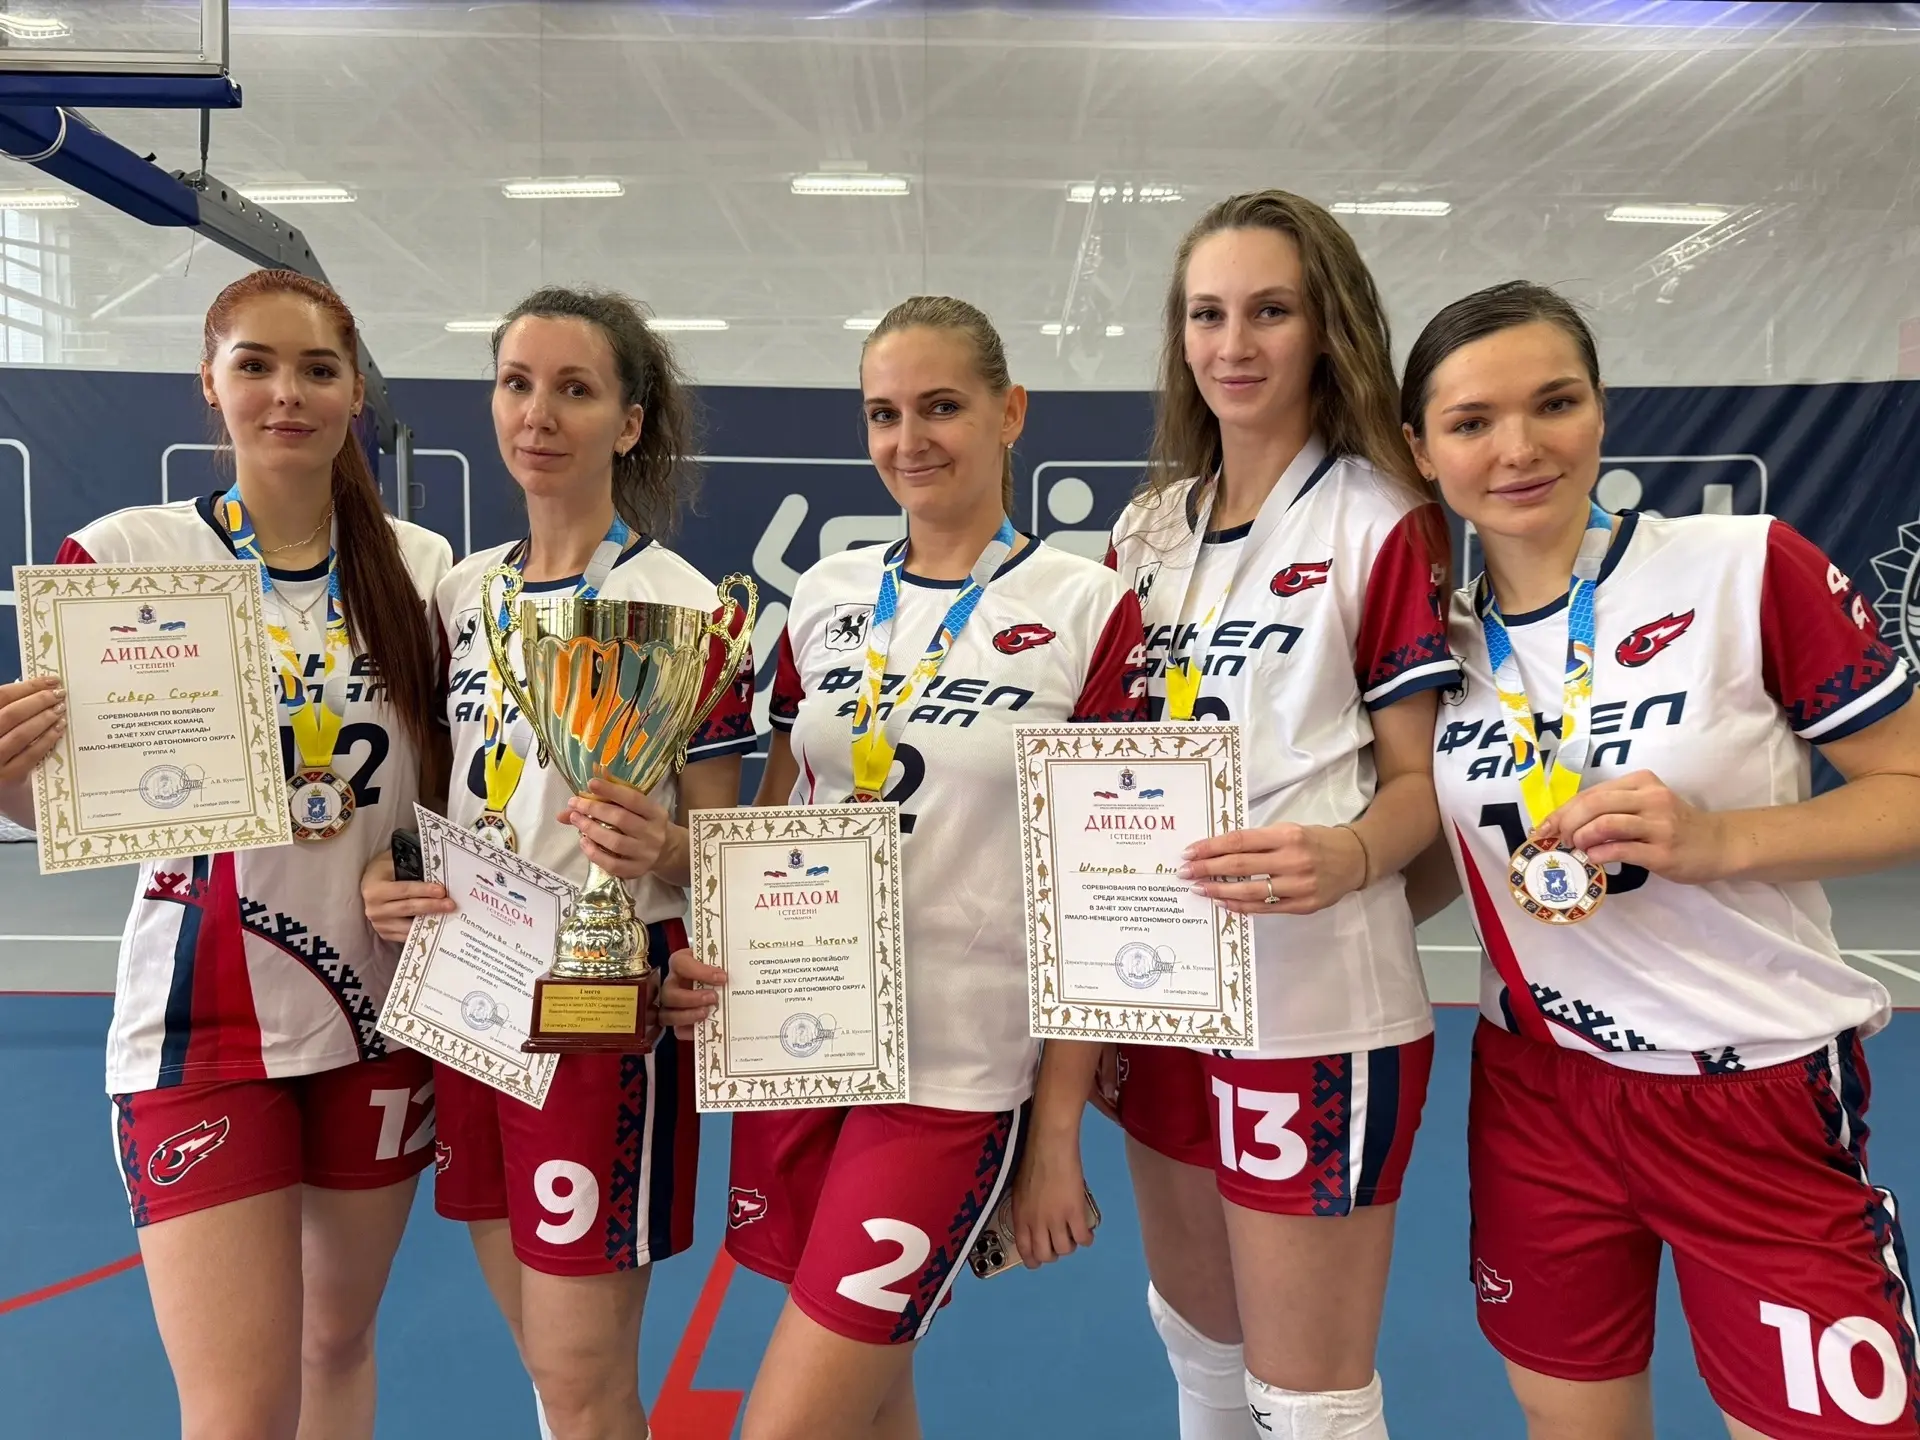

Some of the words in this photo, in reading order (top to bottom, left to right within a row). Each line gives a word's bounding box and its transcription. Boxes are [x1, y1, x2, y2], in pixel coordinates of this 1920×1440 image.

[100, 644, 199, 664] ДИПЛОМ
[134, 662, 175, 670] СТЕПЕНИ
[169, 688, 219, 704] София
[97, 711, 159, 721] СОРЕВНОВАНИЯ
[172, 707, 216, 715] ВОЛЕЙБОЛУ
[137, 720, 173, 728] ЖЕНСКИХ
[173, 717, 204, 725] КОМАНД
[157, 727, 211, 736] СПАРТАКИАДЫ
[78, 740, 152, 752] ЯМАЛО-НЕНЕЦКОГО
[153, 736, 208, 746] АВТОНОМНОГО
[209, 734, 236, 742] ОКРУГА
[1467, 739, 1631, 781] ЯЛ
[1084, 815, 1176, 832] ДИПЛОМ
[1148, 885, 1190, 893] ВОЛЕЙБОЛУ
[469, 887, 534, 928] ДИПЛОМ
[754, 890, 840, 910] ДИПЛОМ
[782, 908, 817, 916] СТЕПЕНИ
[1064, 914, 1128, 922] ЯМАЛО-НЕНЕЦКОГО
[1133, 906, 1184, 914] СПАРТАКИАДЫ
[749, 938, 804, 950] Костина
[816, 935, 858, 946] Наталья
[749, 958, 800, 966] СОРЕВНОВАНИЯ
[812, 955, 850, 963] ВОЛЕЙБОЛУ
[731, 988, 793, 996] ЯМАЛО-НЕНЕЦКОГО
[794, 985, 841, 993] АВТОНОМНОГО
[369, 1079, 436, 1160] 12
[1211, 1075, 1308, 1181] 13
[534, 1160, 600, 1244] 9
[836, 1217, 931, 1313] 2
[1759, 1300, 1909, 1426] 10
